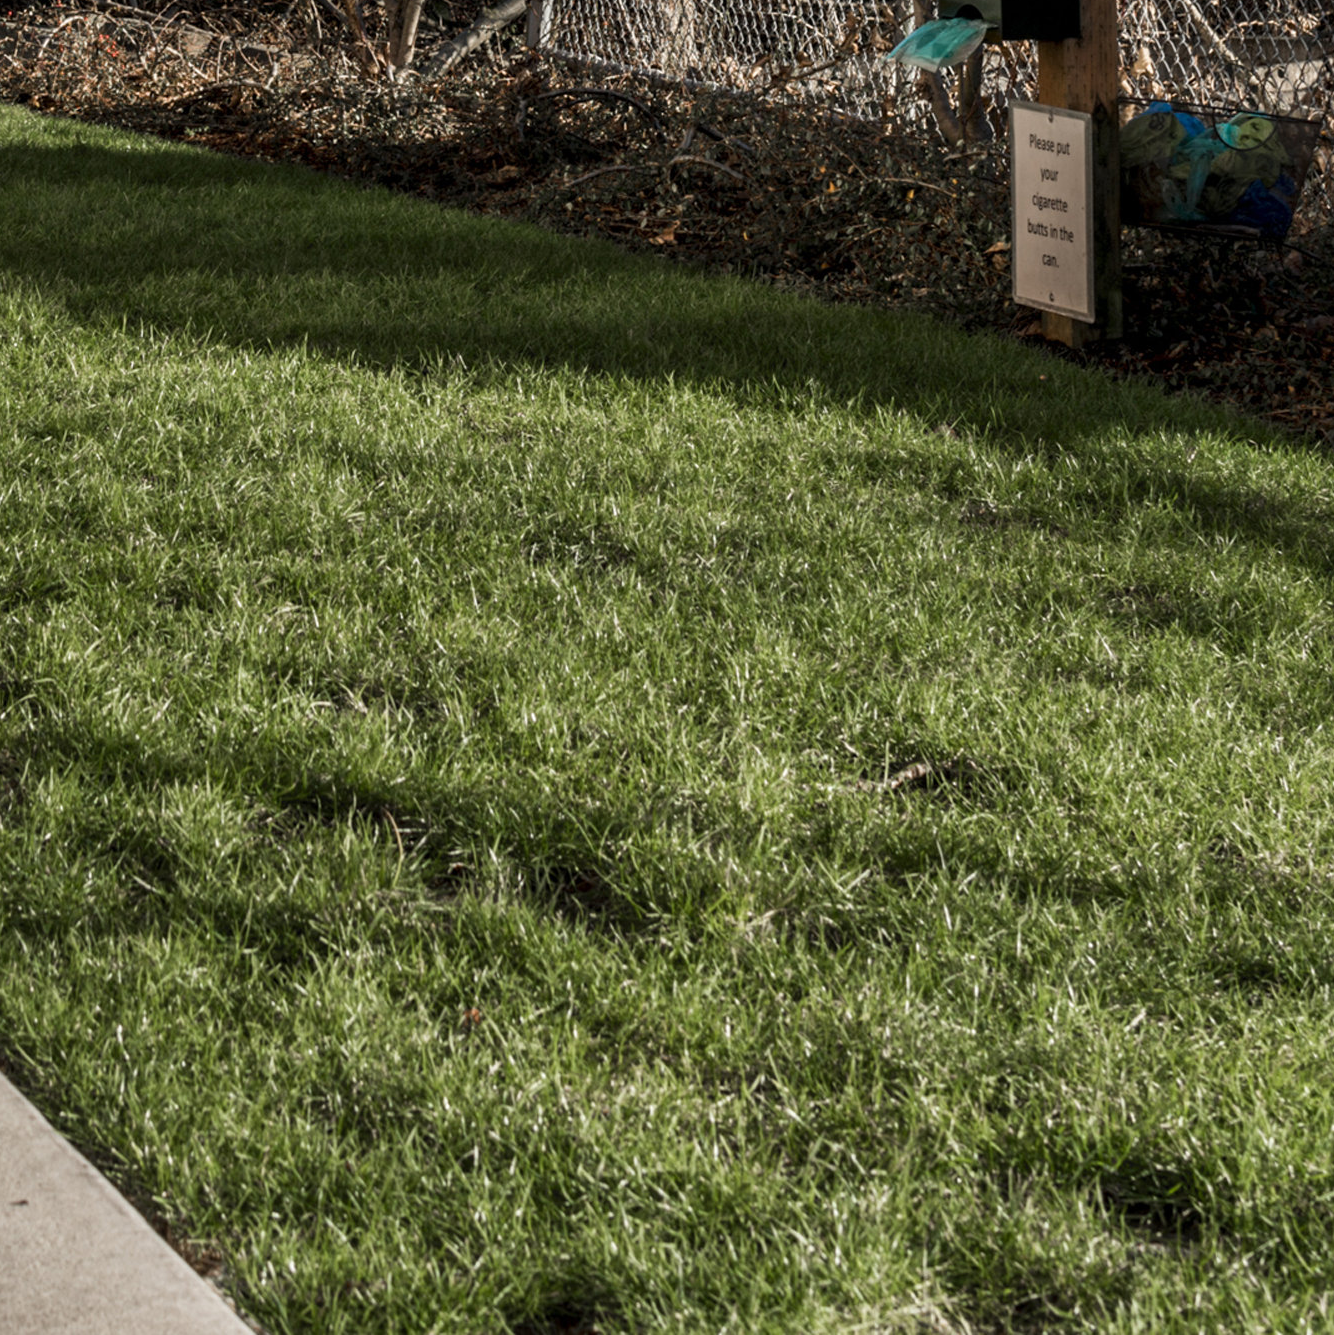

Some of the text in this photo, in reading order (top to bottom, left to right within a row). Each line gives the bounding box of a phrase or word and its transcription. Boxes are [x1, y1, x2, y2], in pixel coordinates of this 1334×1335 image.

[1029, 133, 1070, 156] Please put
[1040, 168, 1059, 182] your
[1032, 192, 1068, 213] cigarette
[1027, 218, 1074, 243] butts in the
[1042, 253, 1060, 268] can.
